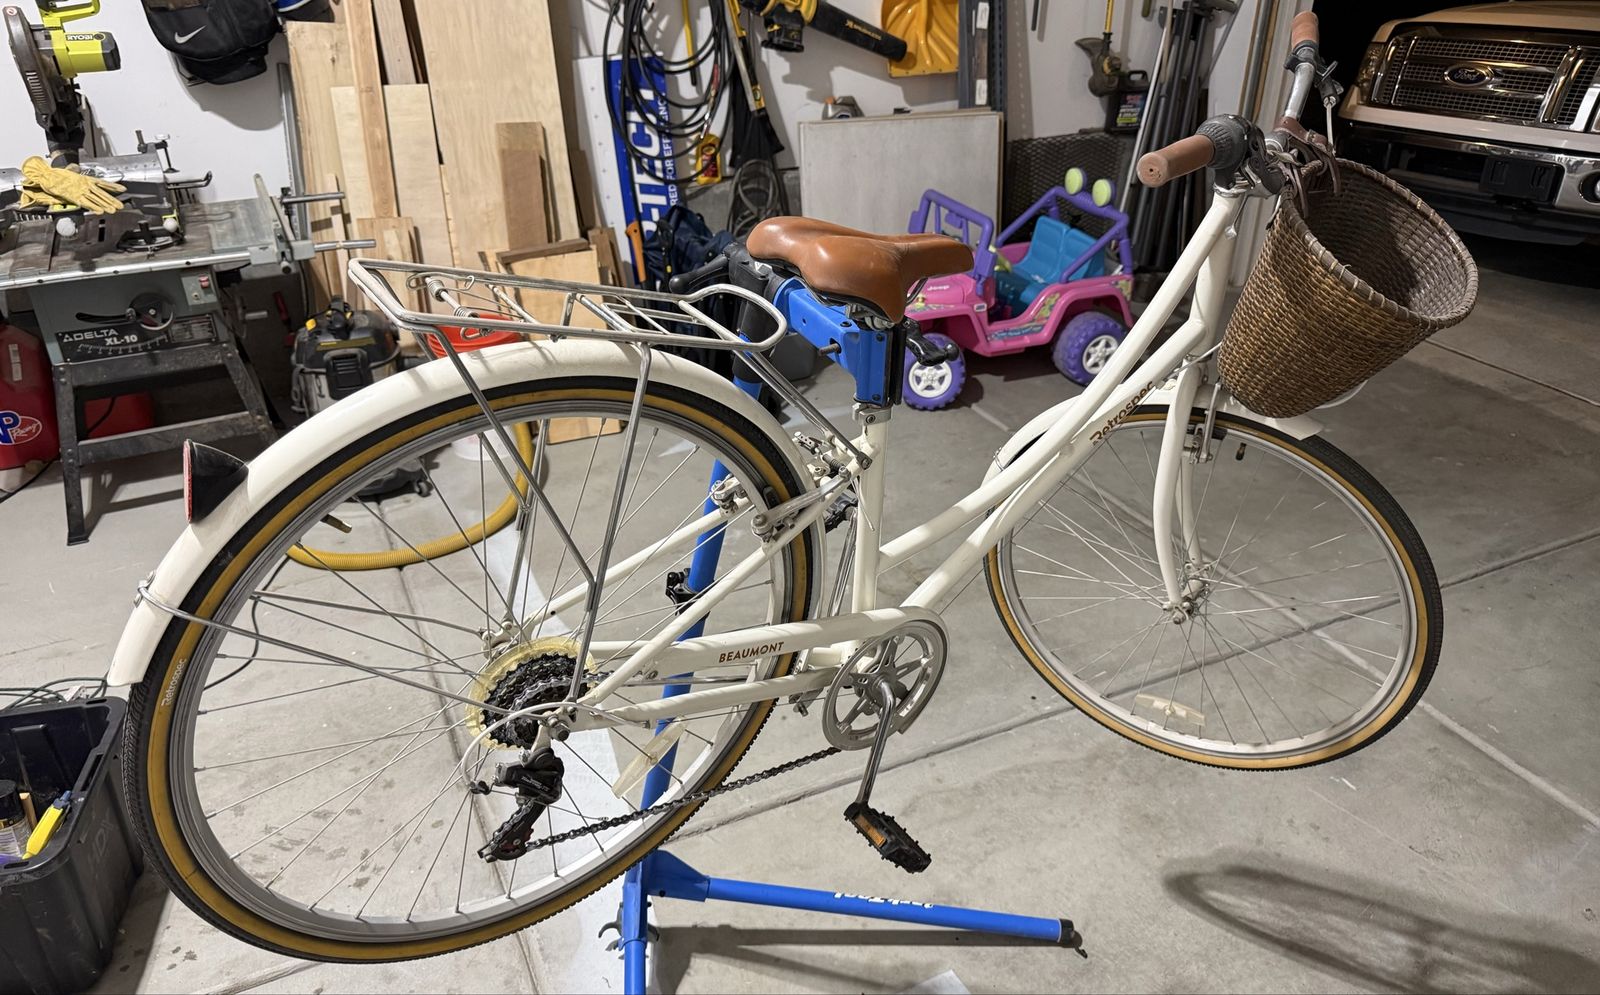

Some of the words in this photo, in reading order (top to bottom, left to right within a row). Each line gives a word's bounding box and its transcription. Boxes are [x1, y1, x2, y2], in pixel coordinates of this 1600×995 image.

[1453, 69, 1480, 81] Ford
[73, 328, 119, 341] DELTA
[104, 334, 138, 346] XL-10
[1089, 381, 1156, 446] Retrospec
[719, 641, 785, 663] BEAUMONT
[161, 658, 187, 706] Retrospec
